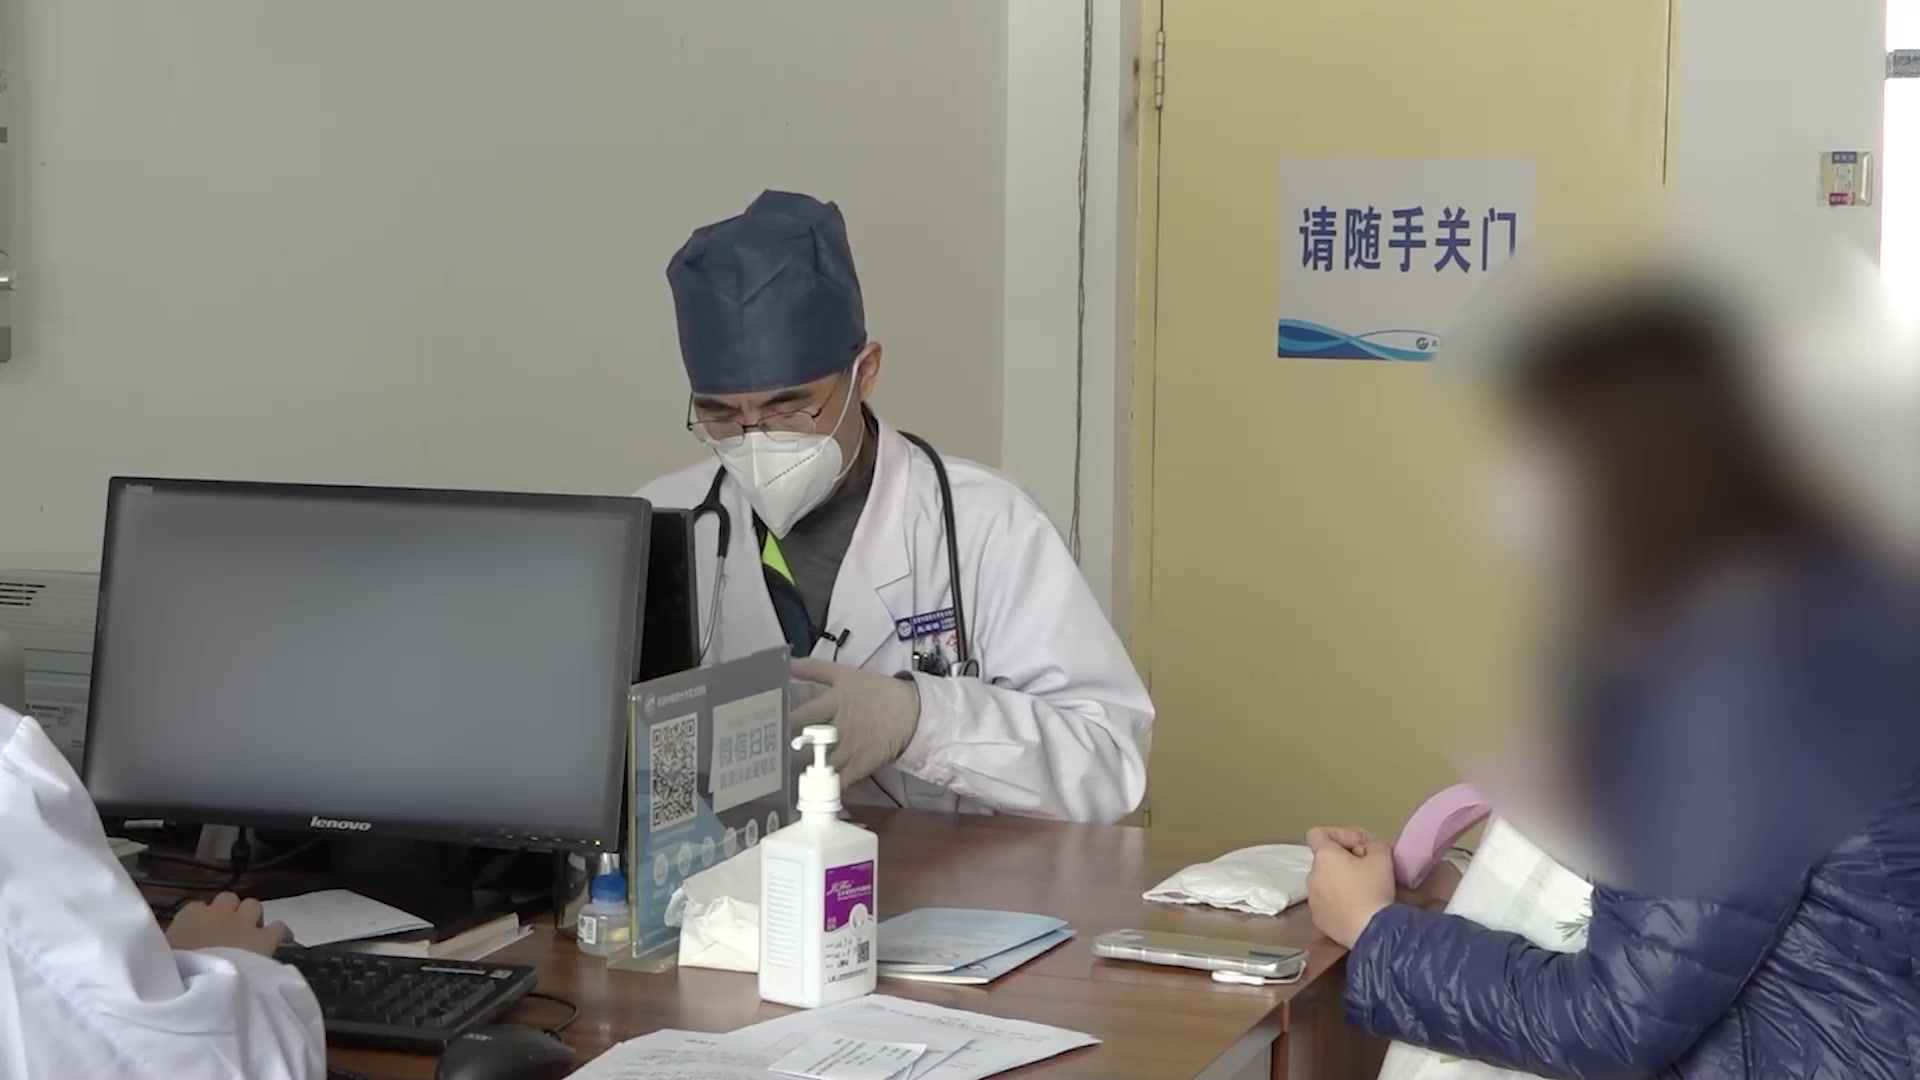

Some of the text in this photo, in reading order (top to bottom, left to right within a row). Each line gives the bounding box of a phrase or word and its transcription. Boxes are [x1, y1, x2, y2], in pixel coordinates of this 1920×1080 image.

[1299, 206, 1517, 272] 请随手关门
[310, 816, 371, 831] lenovo
